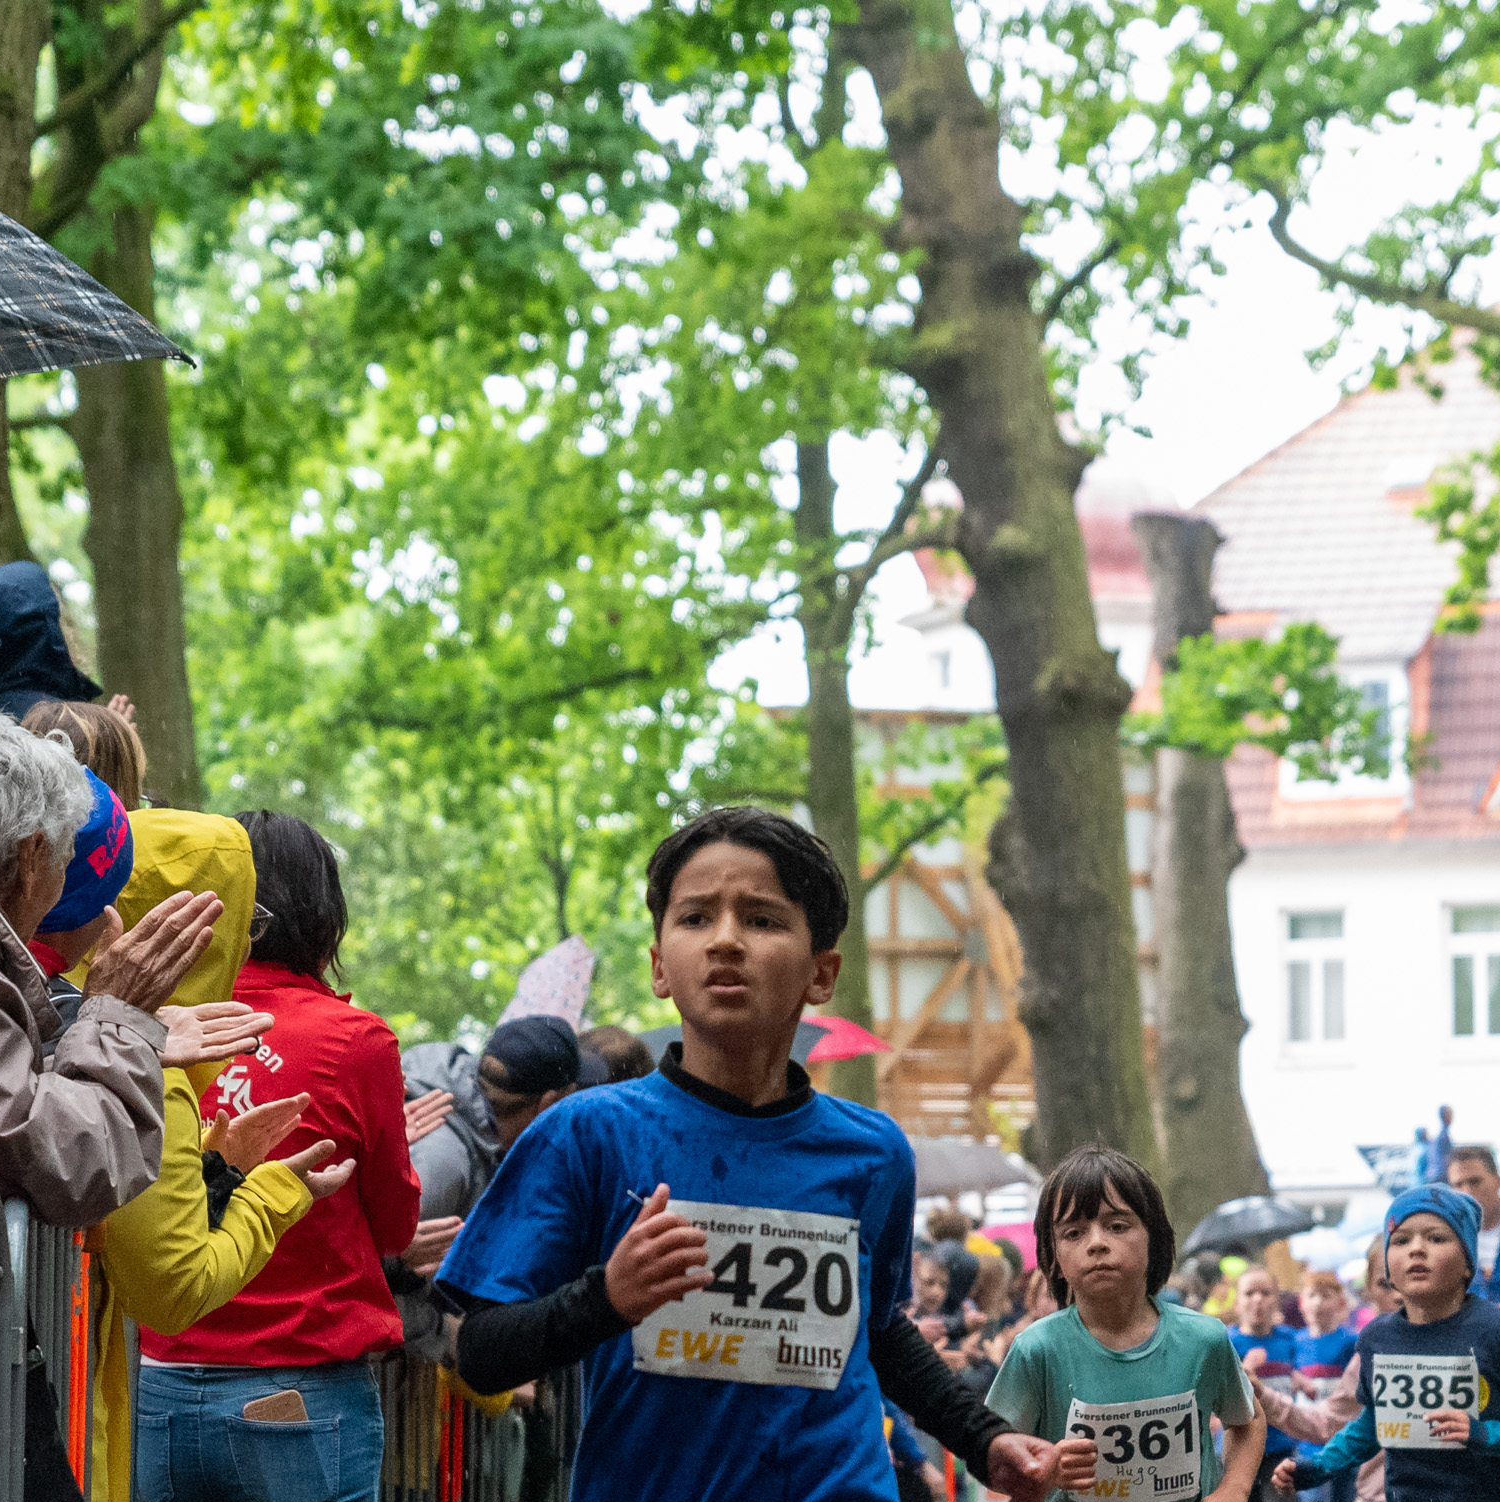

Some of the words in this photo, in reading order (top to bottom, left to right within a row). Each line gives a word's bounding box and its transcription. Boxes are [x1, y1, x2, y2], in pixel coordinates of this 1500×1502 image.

[691, 1218, 755, 1236] rstener
[760, 1223, 849, 1246] Brunnenlauf
[700, 1242, 853, 1317] 420
[710, 1311, 772, 1331] Karzan
[777, 1317, 799, 1333] Ali
[655, 1328, 745, 1365] EWE
[777, 1335, 842, 1369] bruns
[1373, 1373, 1476, 1410] 2385
[1074, 1409, 1131, 1421] Everstener
[1133, 1398, 1193, 1419] Brunnenlauf
[1078, 1478, 1132, 1498] WE
[1116, 1465, 1158, 1486] Hugo
[1153, 1471, 1195, 1493] bruns
